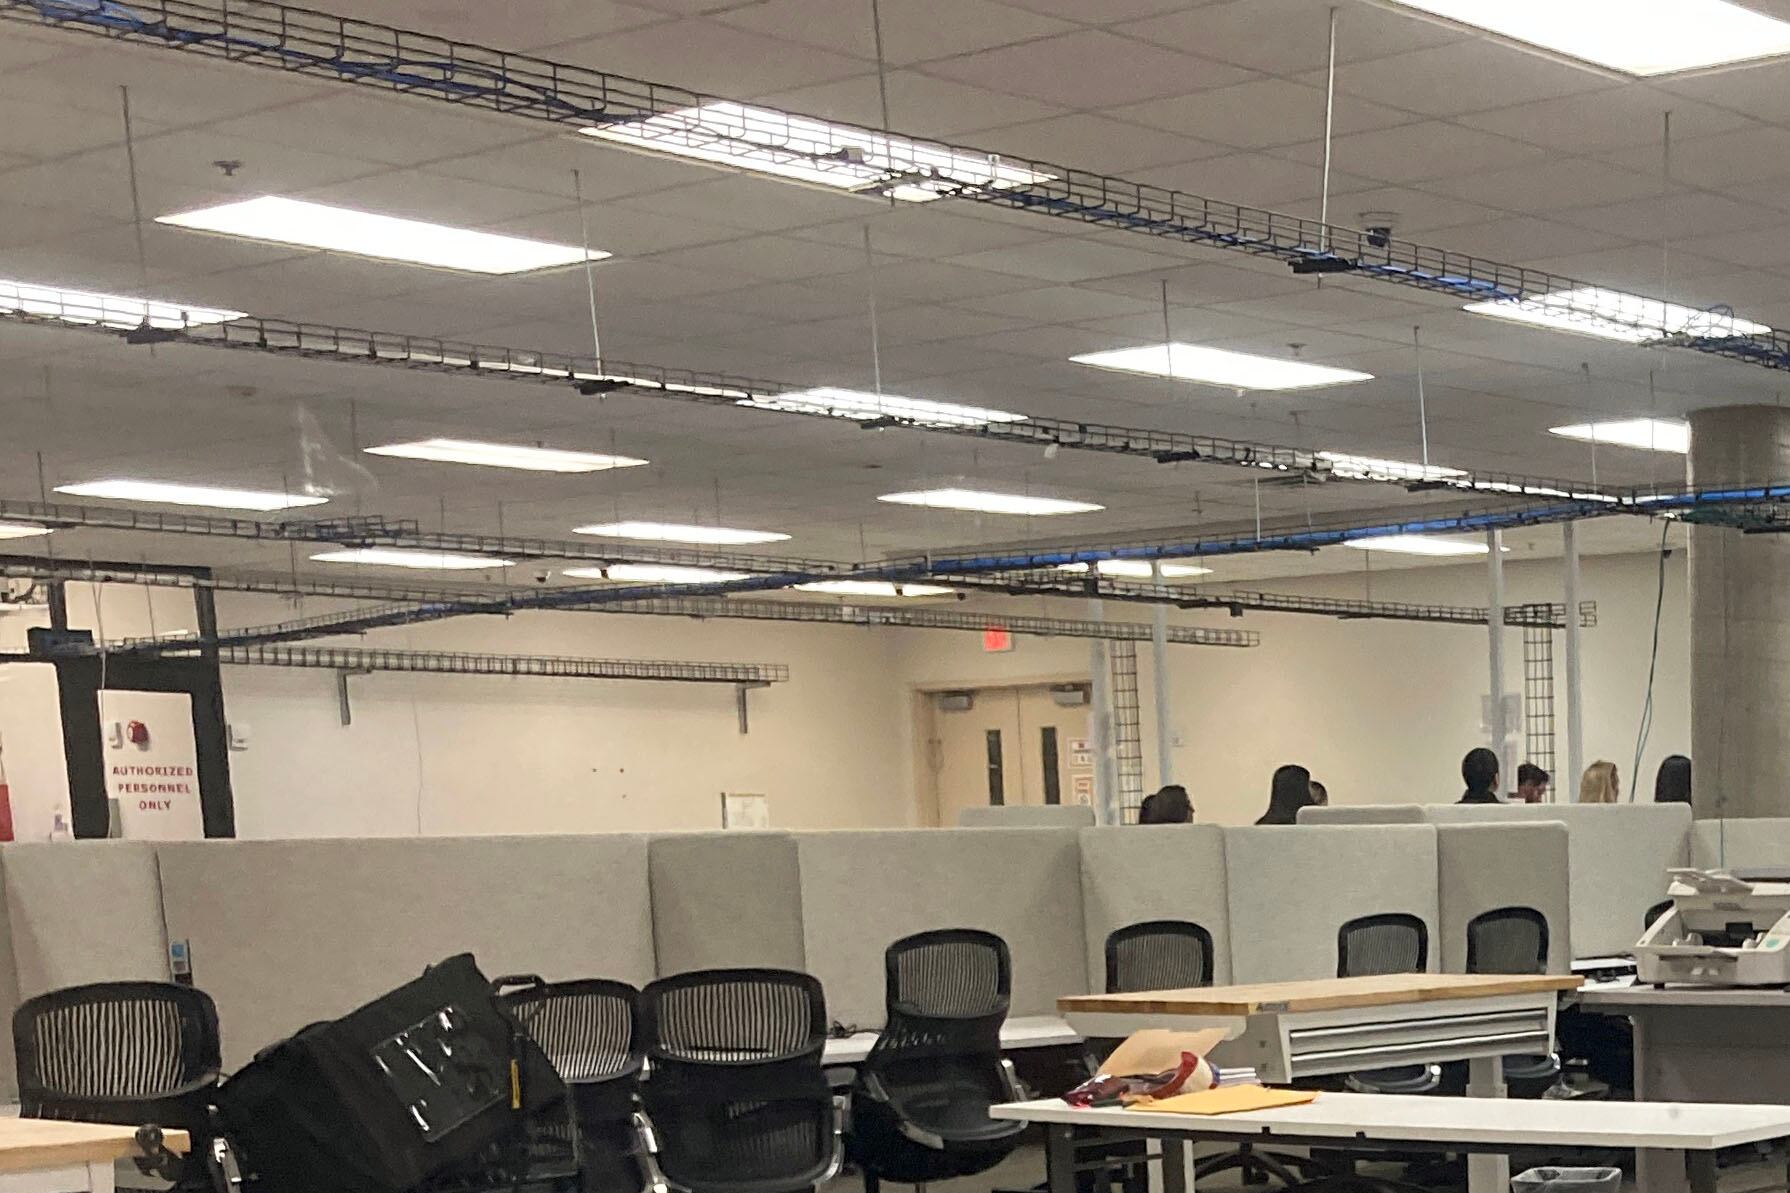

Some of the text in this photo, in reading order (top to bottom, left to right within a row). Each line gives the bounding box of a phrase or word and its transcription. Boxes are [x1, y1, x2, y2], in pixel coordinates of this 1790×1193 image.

[112, 766, 194, 777] AUTHORIZED
[118, 783, 191, 794] PERSONNEL
[139, 799, 172, 810] ONLY
